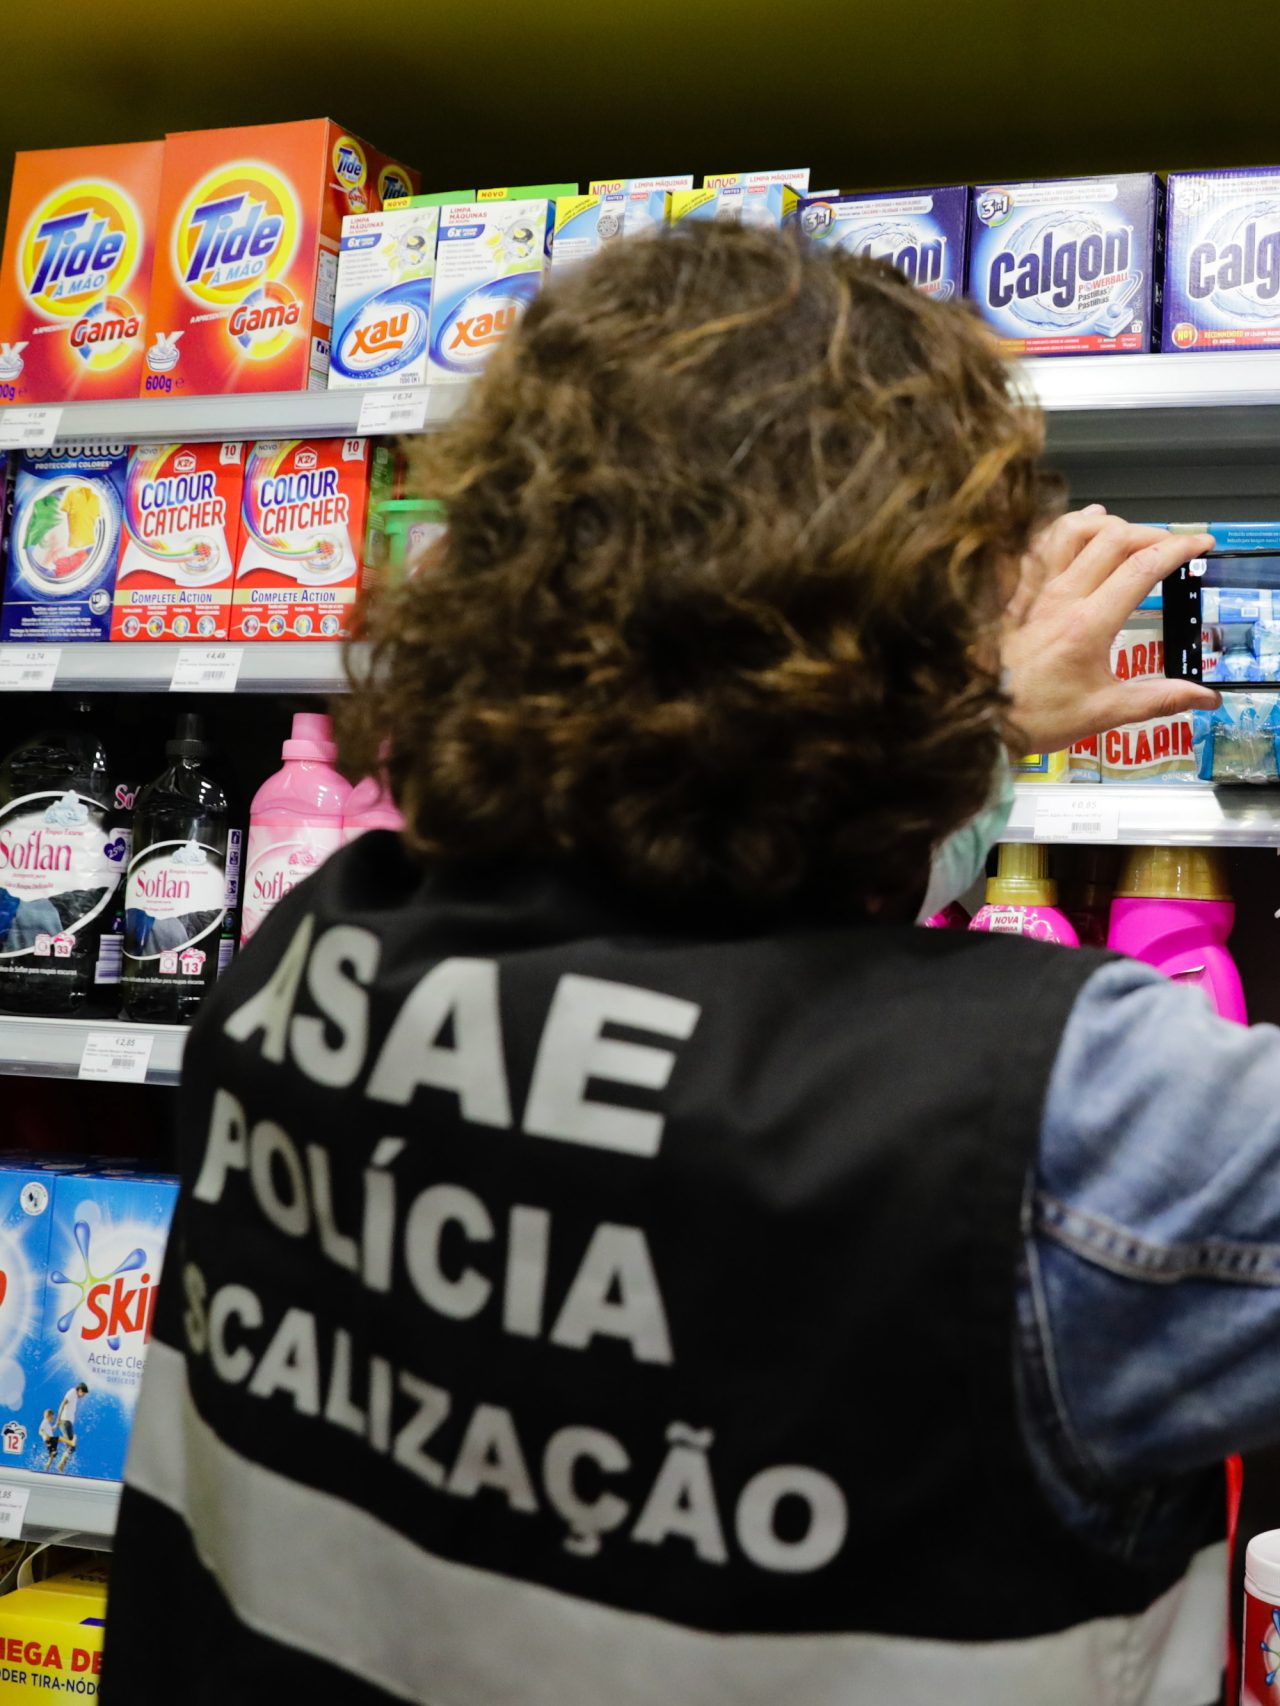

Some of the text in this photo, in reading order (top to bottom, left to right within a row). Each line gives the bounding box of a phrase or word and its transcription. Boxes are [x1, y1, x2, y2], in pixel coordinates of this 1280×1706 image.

[337, 147, 362, 176] Tide
[29, 208, 126, 295] Tide
[184, 193, 284, 285] Tide
[224, 259, 265, 283] MÃO
[988, 226, 1130, 308] Calgon
[68, 273, 106, 296] MÃO
[70, 315, 139, 348] Gama
[228, 301, 301, 336] Gama
[348, 312, 410, 357] xau
[448, 306, 517, 350] xau
[145, 375, 172, 392] 600g
[224, 444, 237, 457] 10
[347, 440, 360, 453] 10
[141, 472, 214, 511] COLOUR
[260, 469, 337, 508] COLOUR
[143, 499, 224, 538] CATCHER
[262, 496, 348, 536] CATCHER
[131, 590, 212, 604] COMPLETE ACTION
[251, 589, 336, 603] COMPLETE ACTION
[0, 829, 72, 872] Soflan
[135, 868, 191, 900] Soflan
[184, 962, 199, 974] 13
[223, 912, 702, 1158] ASAE
[193, 1086, 675, 1367] POLÍCIA
[88, 1352, 124, 1367] Active
[7, 1436, 19, 1450] 12
[0, 1636, 63, 1670] EGA
